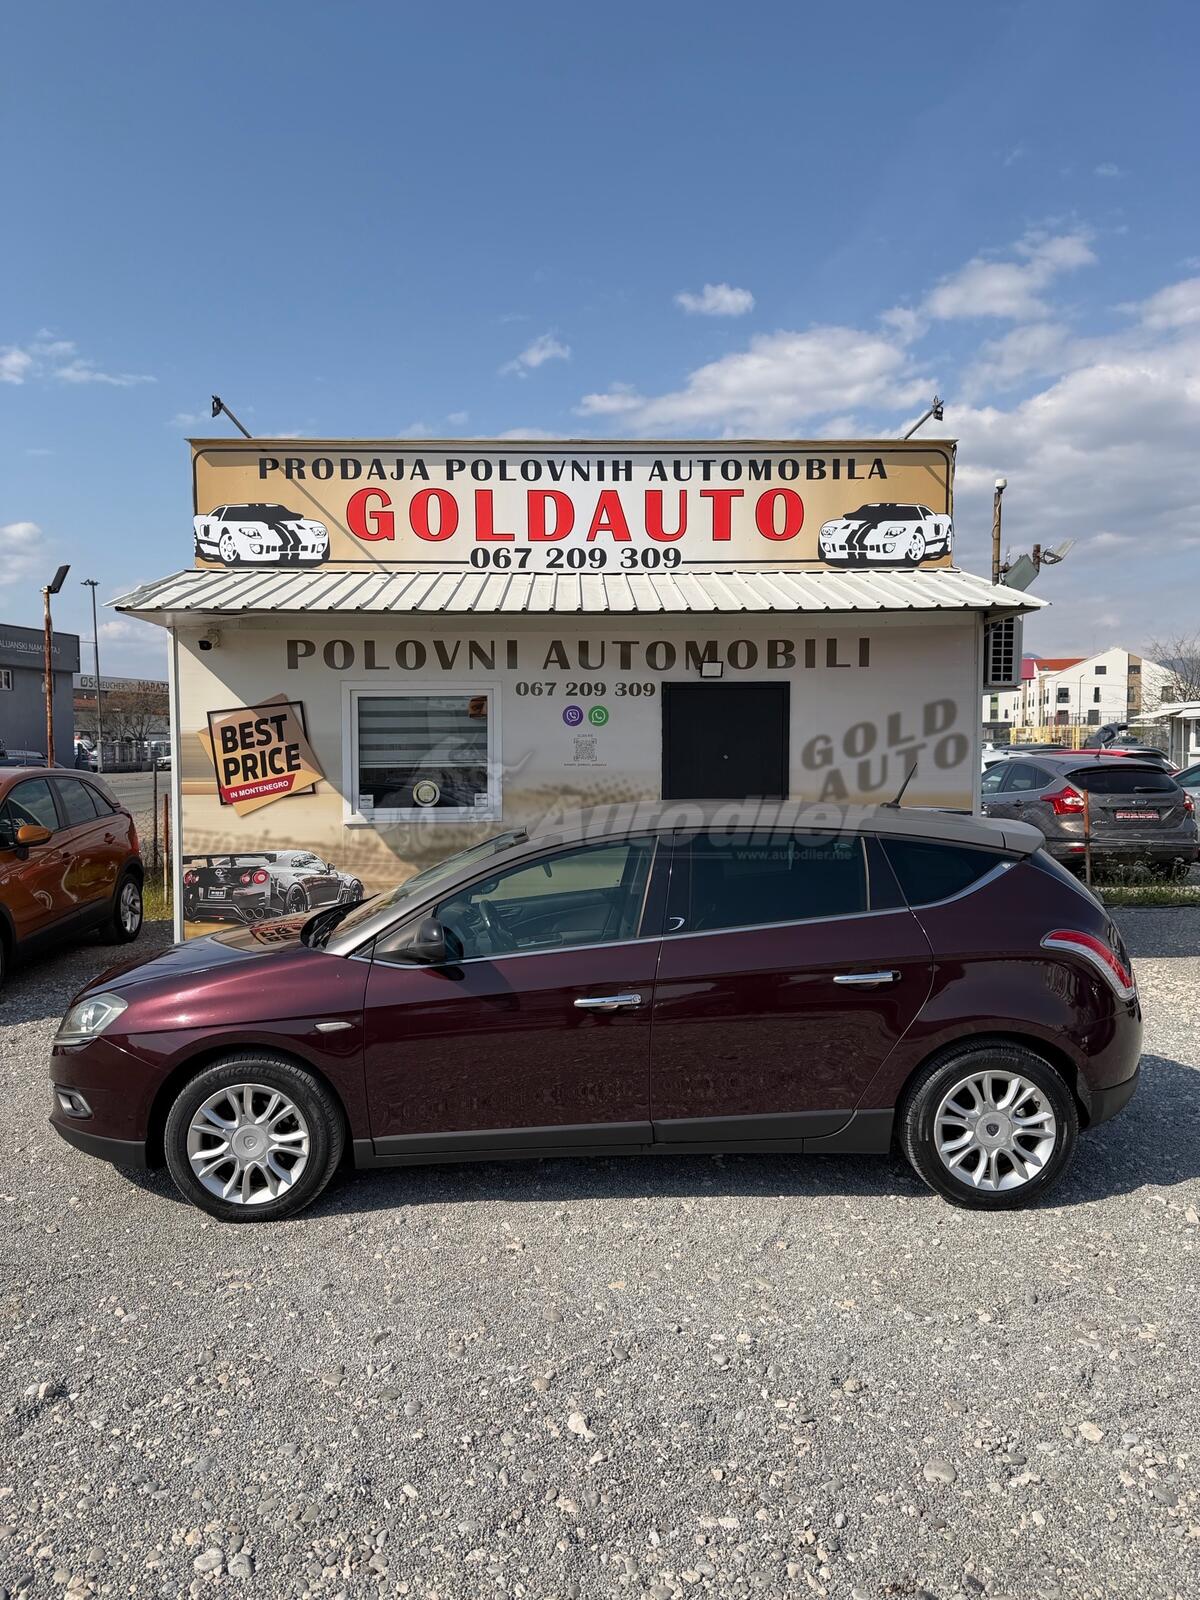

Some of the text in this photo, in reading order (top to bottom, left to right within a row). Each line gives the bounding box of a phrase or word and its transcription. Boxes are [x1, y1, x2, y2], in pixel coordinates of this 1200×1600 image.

[258, 457, 888, 482] PRODAJA POLOVNIH AUTOMOBILA
[346, 487, 805, 542] GOLDAUTO
[469, 547, 682, 569] 067 209 309
[286, 637, 871, 671] POLOVNI AUTOMOBILI
[515, 681, 656, 697] 067 209 309
[220, 714, 288, 754] BEST
[801, 698, 958, 772] GOLD
[223, 743, 301, 786] PRICE
[819, 732, 970, 802] AUTO
[230, 780, 289, 799] IN MONTENEGRO
